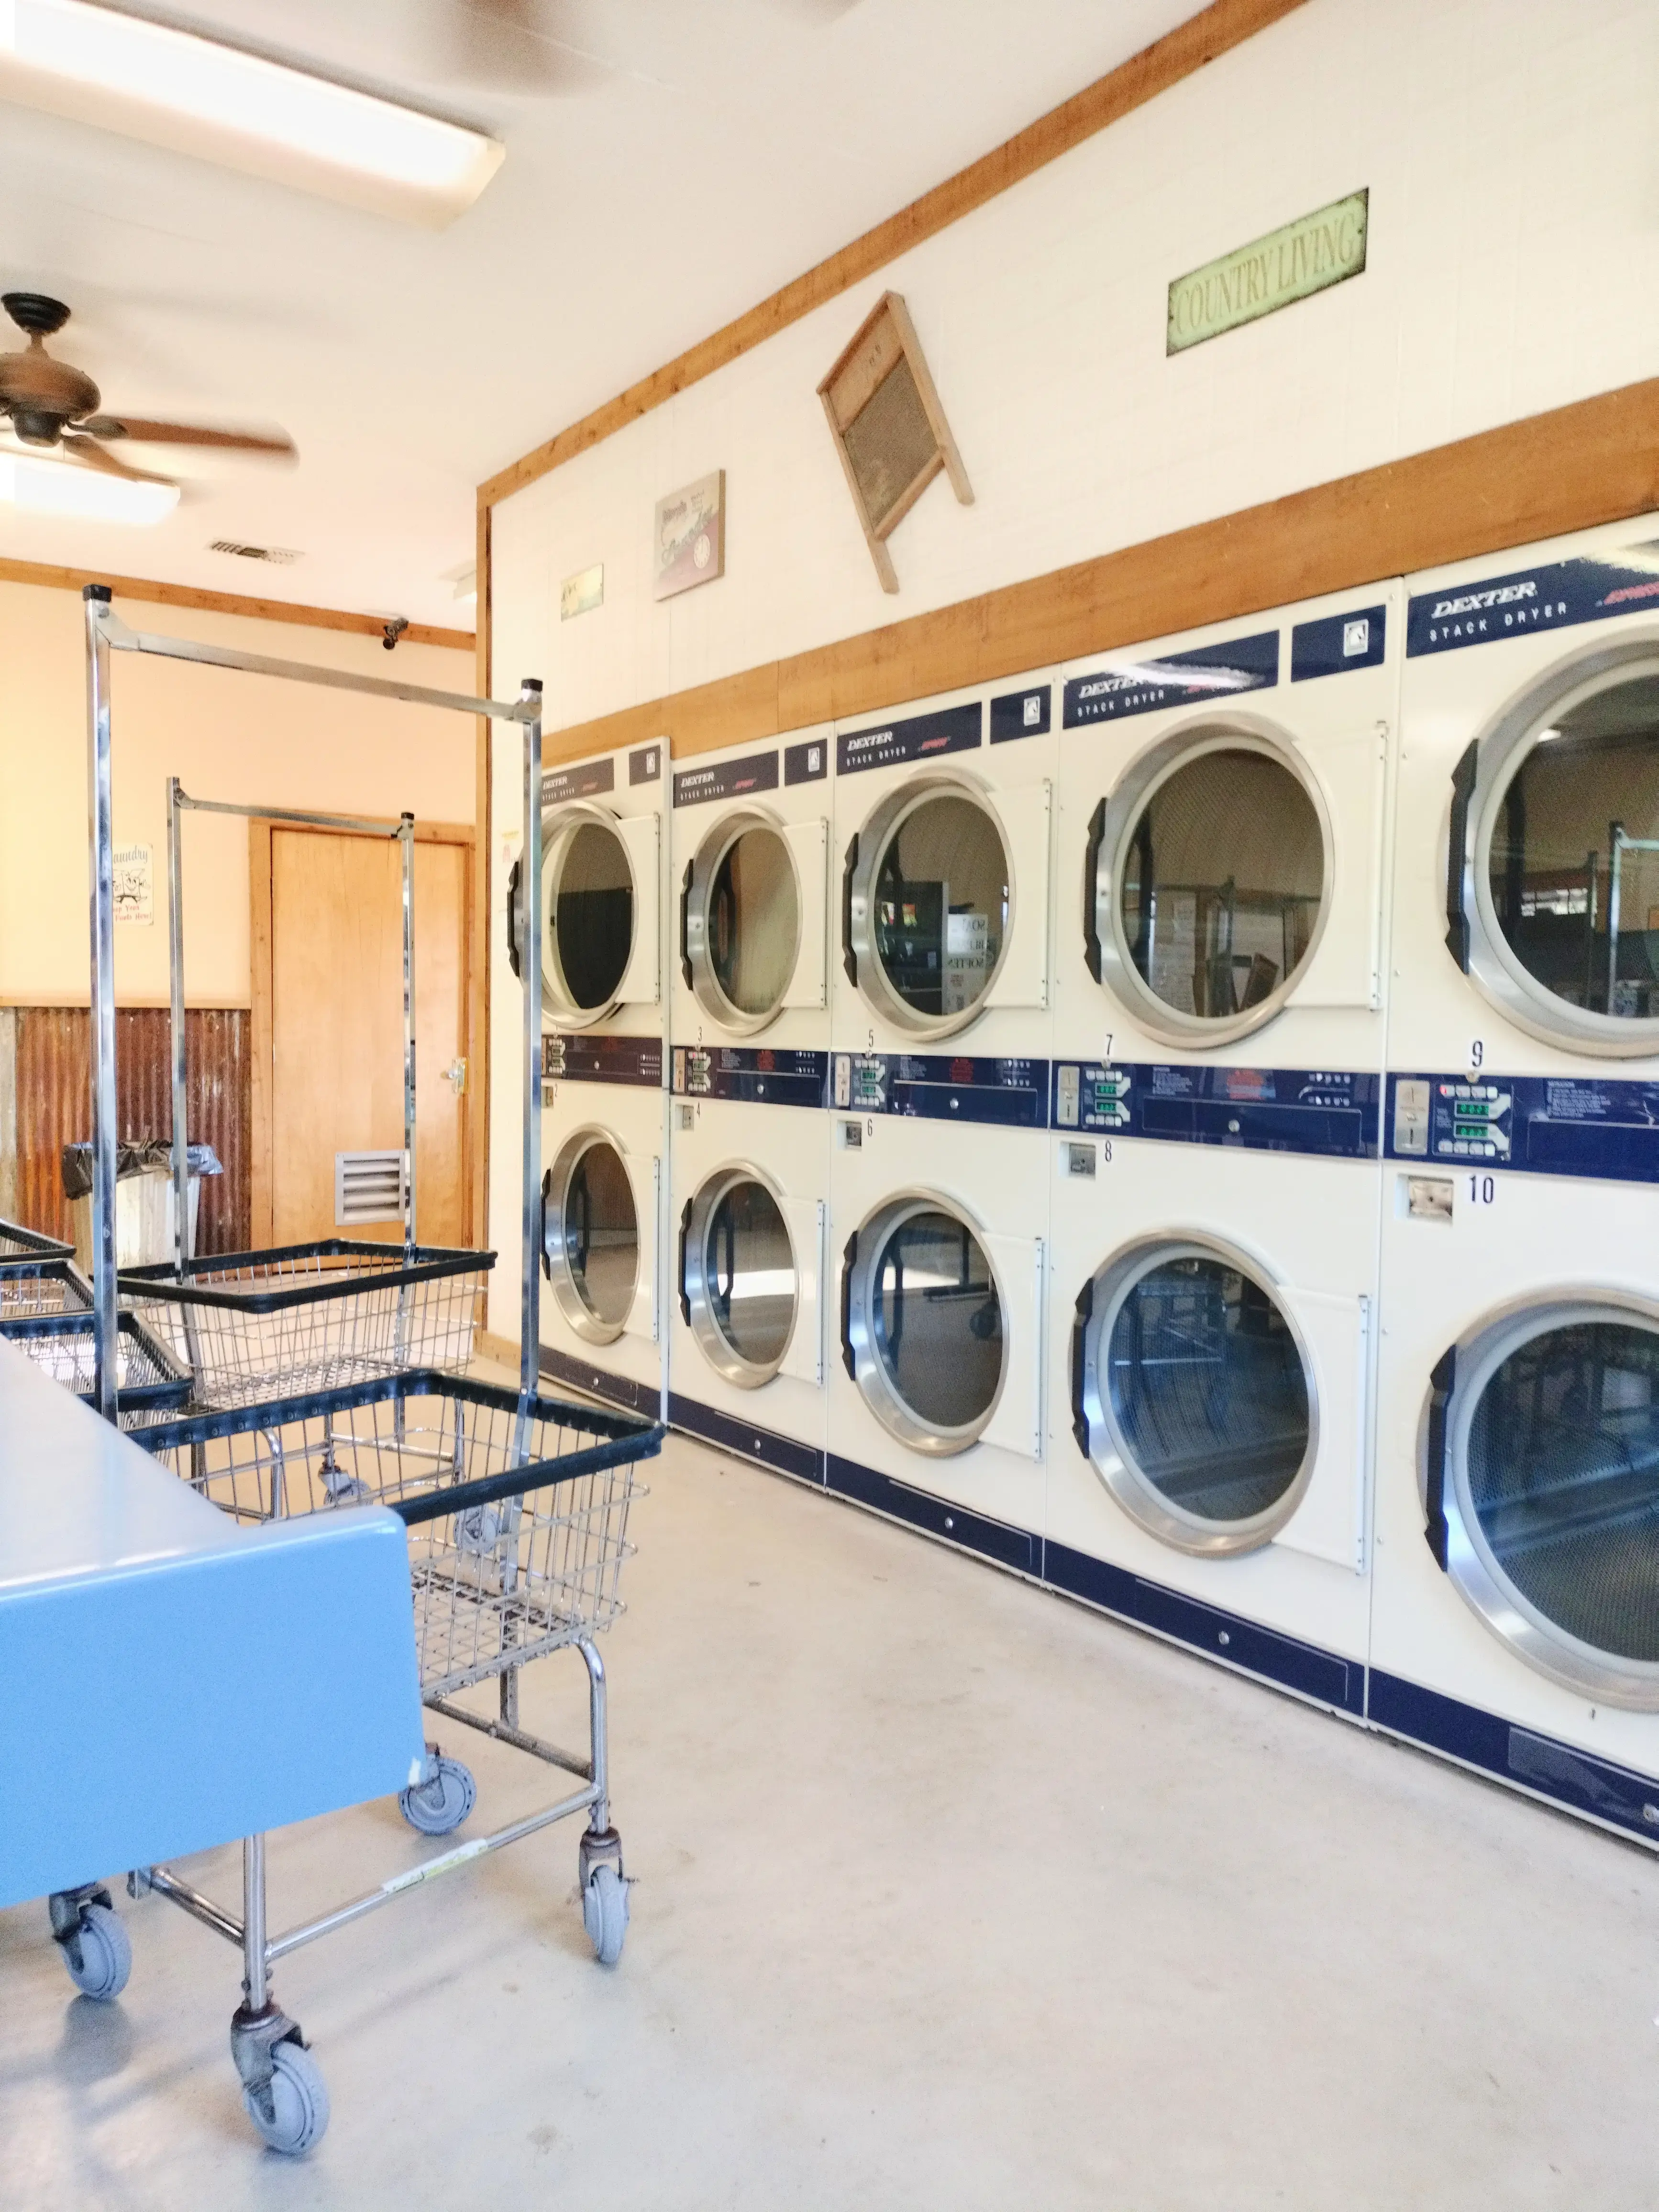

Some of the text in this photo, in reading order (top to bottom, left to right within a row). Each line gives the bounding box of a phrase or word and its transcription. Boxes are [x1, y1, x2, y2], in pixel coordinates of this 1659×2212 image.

[1175, 212, 1356, 335] COUNTRY LIVING
[1431, 580, 1538, 619] DEXTER
[1429, 601, 1567, 642] STACK DRYER
[1077, 699, 1115, 718] STACK
[1125, 689, 1165, 708] DRYER
[846, 730, 894, 752] DEXTER
[846, 745, 906, 767] STACK DRYER
[542, 775, 568, 790] DEXTER
[680, 771, 715, 788] DEXTER
[113, 845, 148, 864] aundry
[698, 1026, 702, 1041] 3
[868, 1029, 874, 1047] 5
[1106, 1034, 1113, 1055] 7
[1472, 1040, 1483, 1067] 9
[554, 1083, 558, 1098] 2
[697, 1101, 700, 1117] 4
[867, 1118, 873, 1137] 6
[1105, 1140, 1112, 1162] 8
[1469, 1175, 1494, 1204] 10
